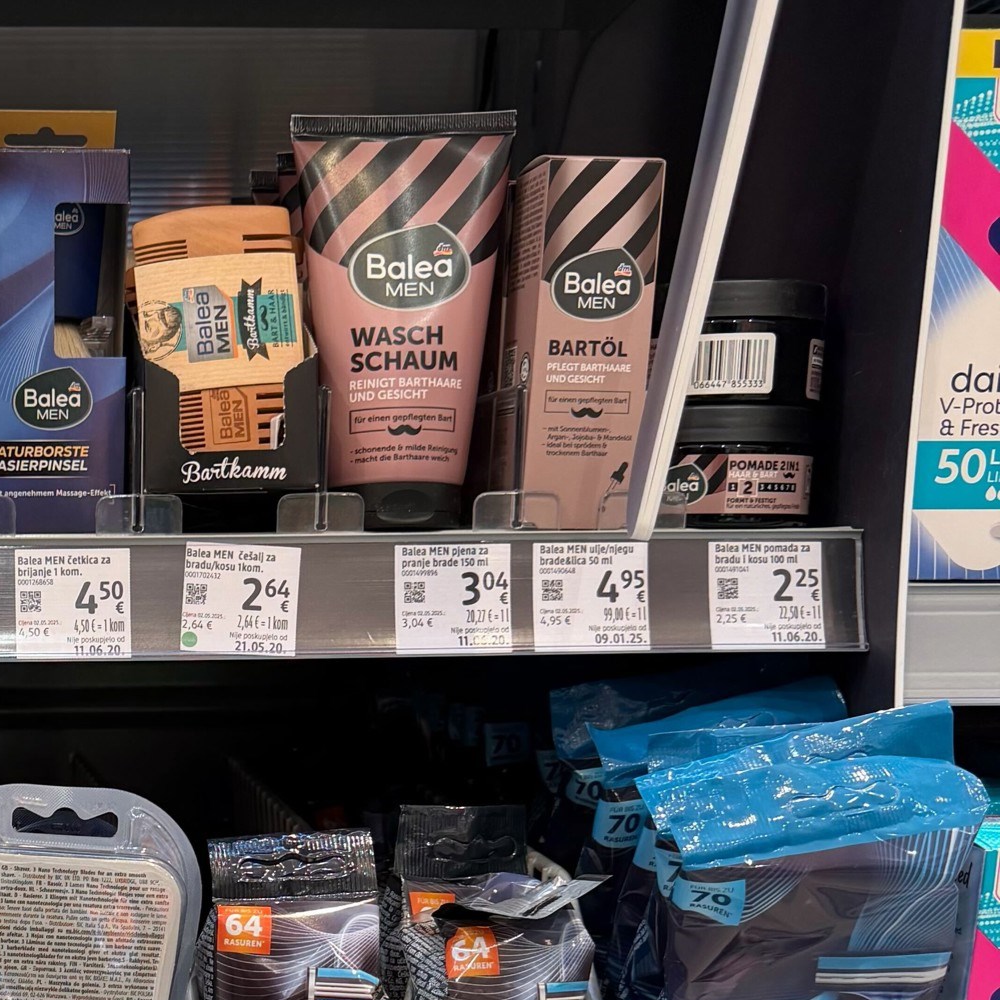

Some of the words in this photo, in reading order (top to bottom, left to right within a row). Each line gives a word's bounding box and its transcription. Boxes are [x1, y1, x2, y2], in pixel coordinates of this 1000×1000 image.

[366, 253, 453, 280] Balea
[385, 282, 435, 297] MEN
[564, 272, 630, 296] Balea
[578, 296, 616, 310] MEN
[196, 292, 214, 356] Balea
[214, 305, 231, 353] MEN
[351, 326, 443, 347] WASCH
[548, 336, 627, 357] BARTÖL
[351, 351, 457, 372] SCHAUM
[547, 363, 579, 372] PFLEGT
[580, 363, 631, 372] BARTHAARE
[350, 379, 395, 390] REINIGT
[399, 378, 462, 389] BARTHAARE
[546, 375, 564, 383] UND
[566, 375, 605, 384] GESICHT
[24, 387, 81, 408] Balea
[350, 391, 375, 402] UND
[377, 389, 428, 400] GESICHT
[36, 407, 68, 420] MEN
[940, 419, 954, 436] &
[960, 419, 999, 436] Fres
[181, 457, 286, 484] Bartkamm
[934, 449, 986, 484] 50
[186, 548, 211, 559] Balea
[214, 550, 234, 560] MEN
[238, 550, 264, 563] češalj
[266, 554, 276, 562] za
[715, 544, 739, 553] Balea
[742, 544, 761, 552] MEN
[764, 544, 798, 554] pomada
[595, 634, 647, 644] 09.01.25.
[772, 632, 822, 642] 11.06.20.
[607, 813, 641, 834] 70
[691, 890, 731, 906] 70
[225, 914, 263, 937] 64
